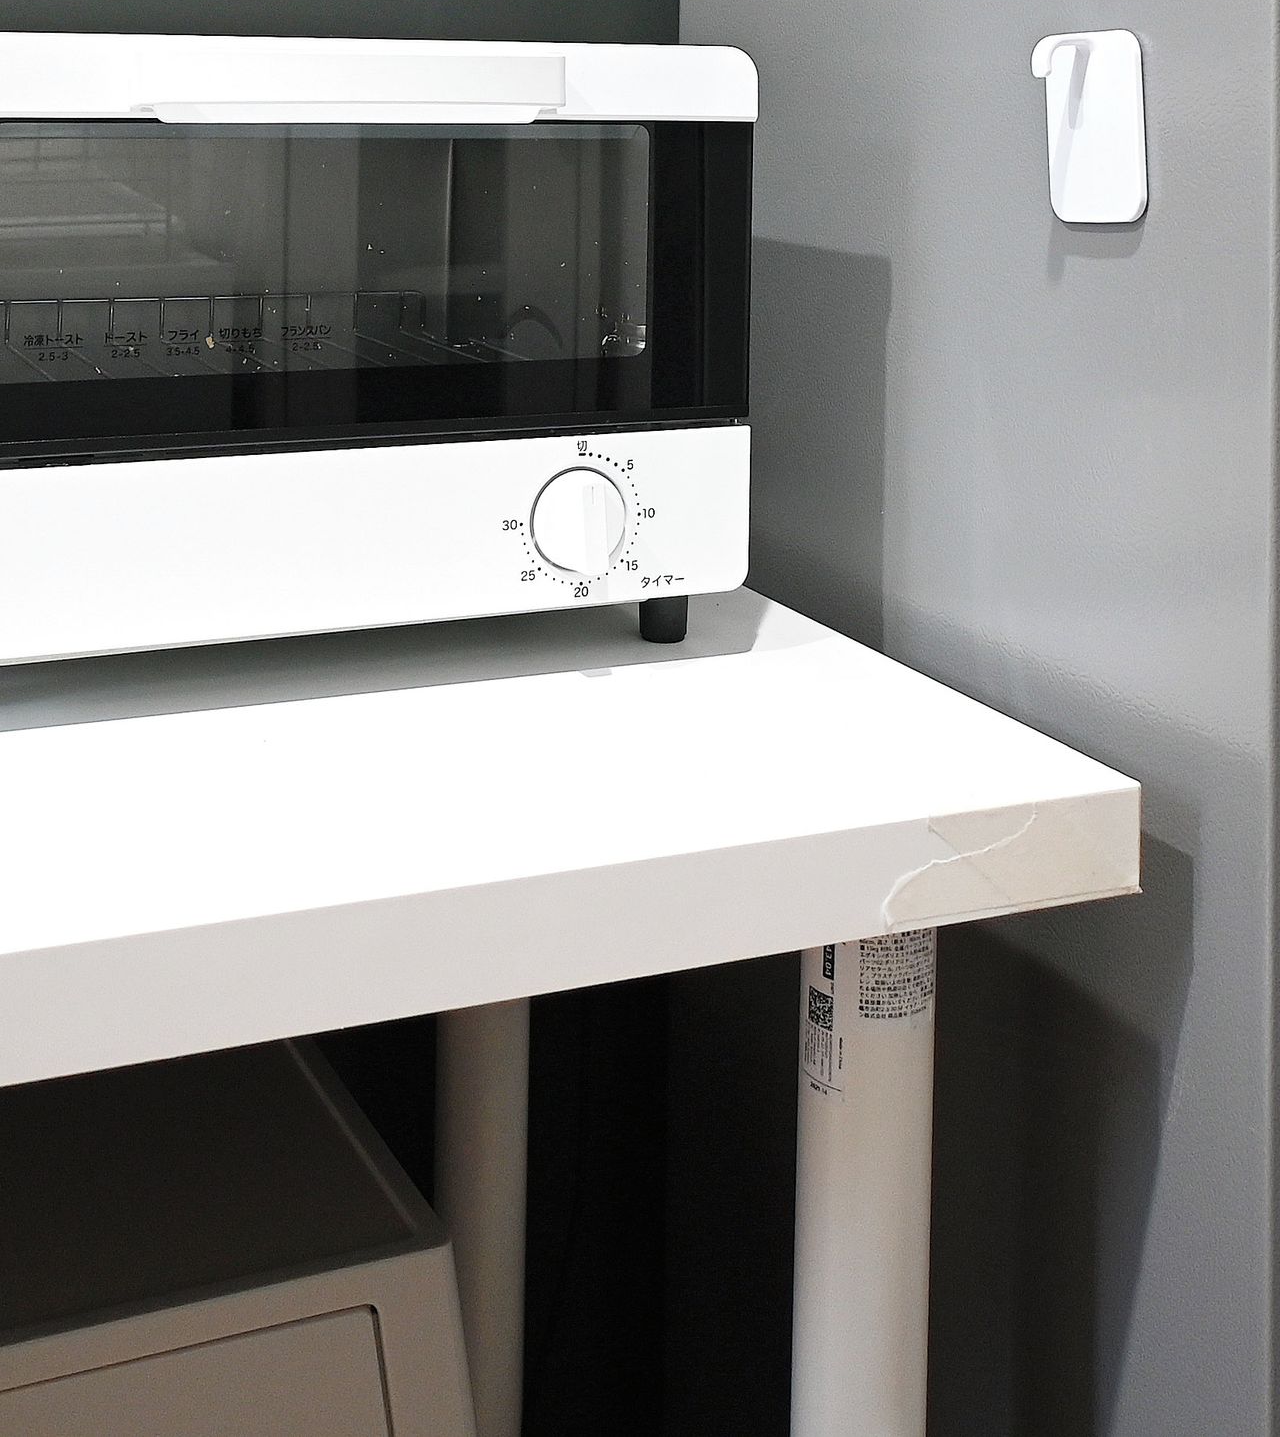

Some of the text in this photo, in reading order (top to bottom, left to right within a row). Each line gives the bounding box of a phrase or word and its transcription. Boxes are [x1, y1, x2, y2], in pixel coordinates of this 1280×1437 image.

[105, 331, 148, 343] トースト
[168, 329, 200, 341] フライ
[219, 327, 263, 339] 切りもち
[281, 325, 332, 337] フランスパン
[23, 333, 84, 347] 冷凍トースト
[577, 440, 588, 451] 切
[627, 460, 634, 470] 5
[642, 508, 656, 518] 10
[502, 519, 518, 531] 30
[626, 560, 638, 571] 15
[521, 570, 536, 581] 25
[640, 575, 685, 588] タイマー
[574, 587, 589, 597] 20
